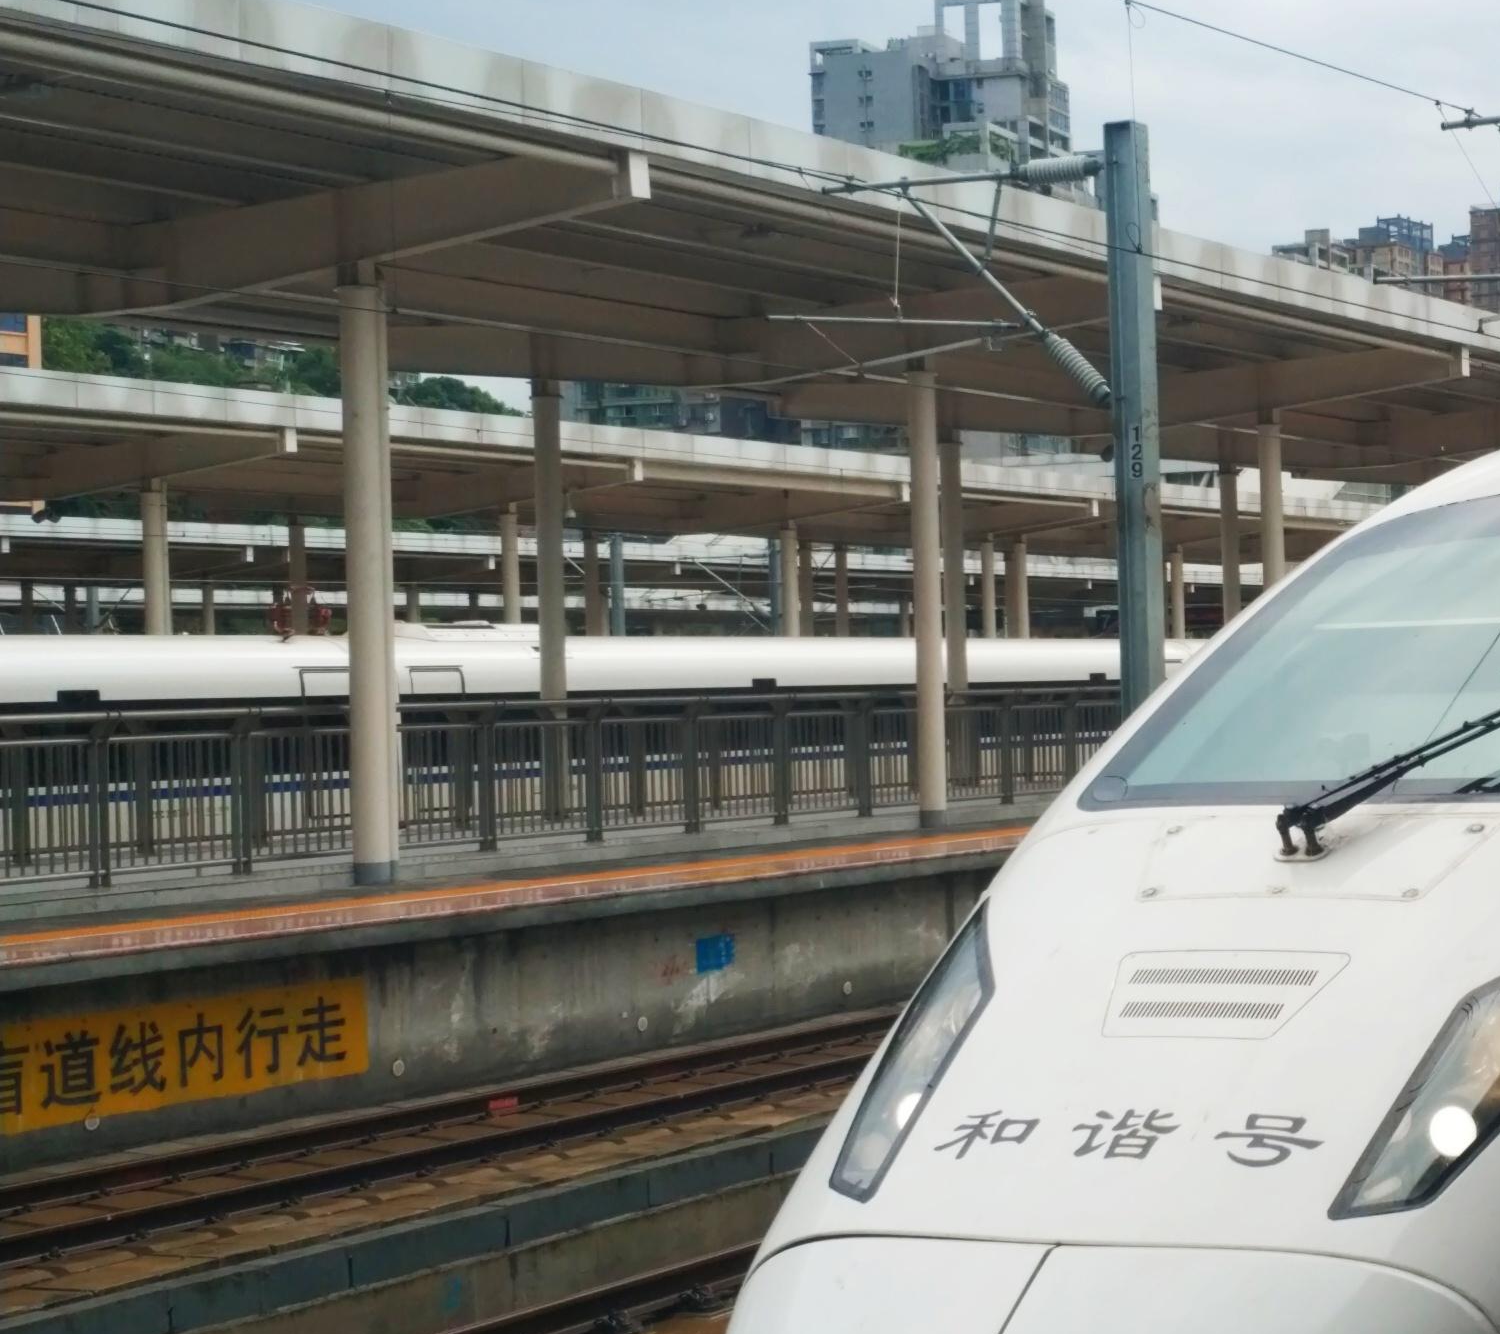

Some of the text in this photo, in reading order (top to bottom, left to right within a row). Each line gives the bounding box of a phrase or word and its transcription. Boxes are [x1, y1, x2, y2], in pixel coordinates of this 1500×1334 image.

[1131, 425, 1143, 478] 129
[933, 1107, 1324, 1168] 和谐号
